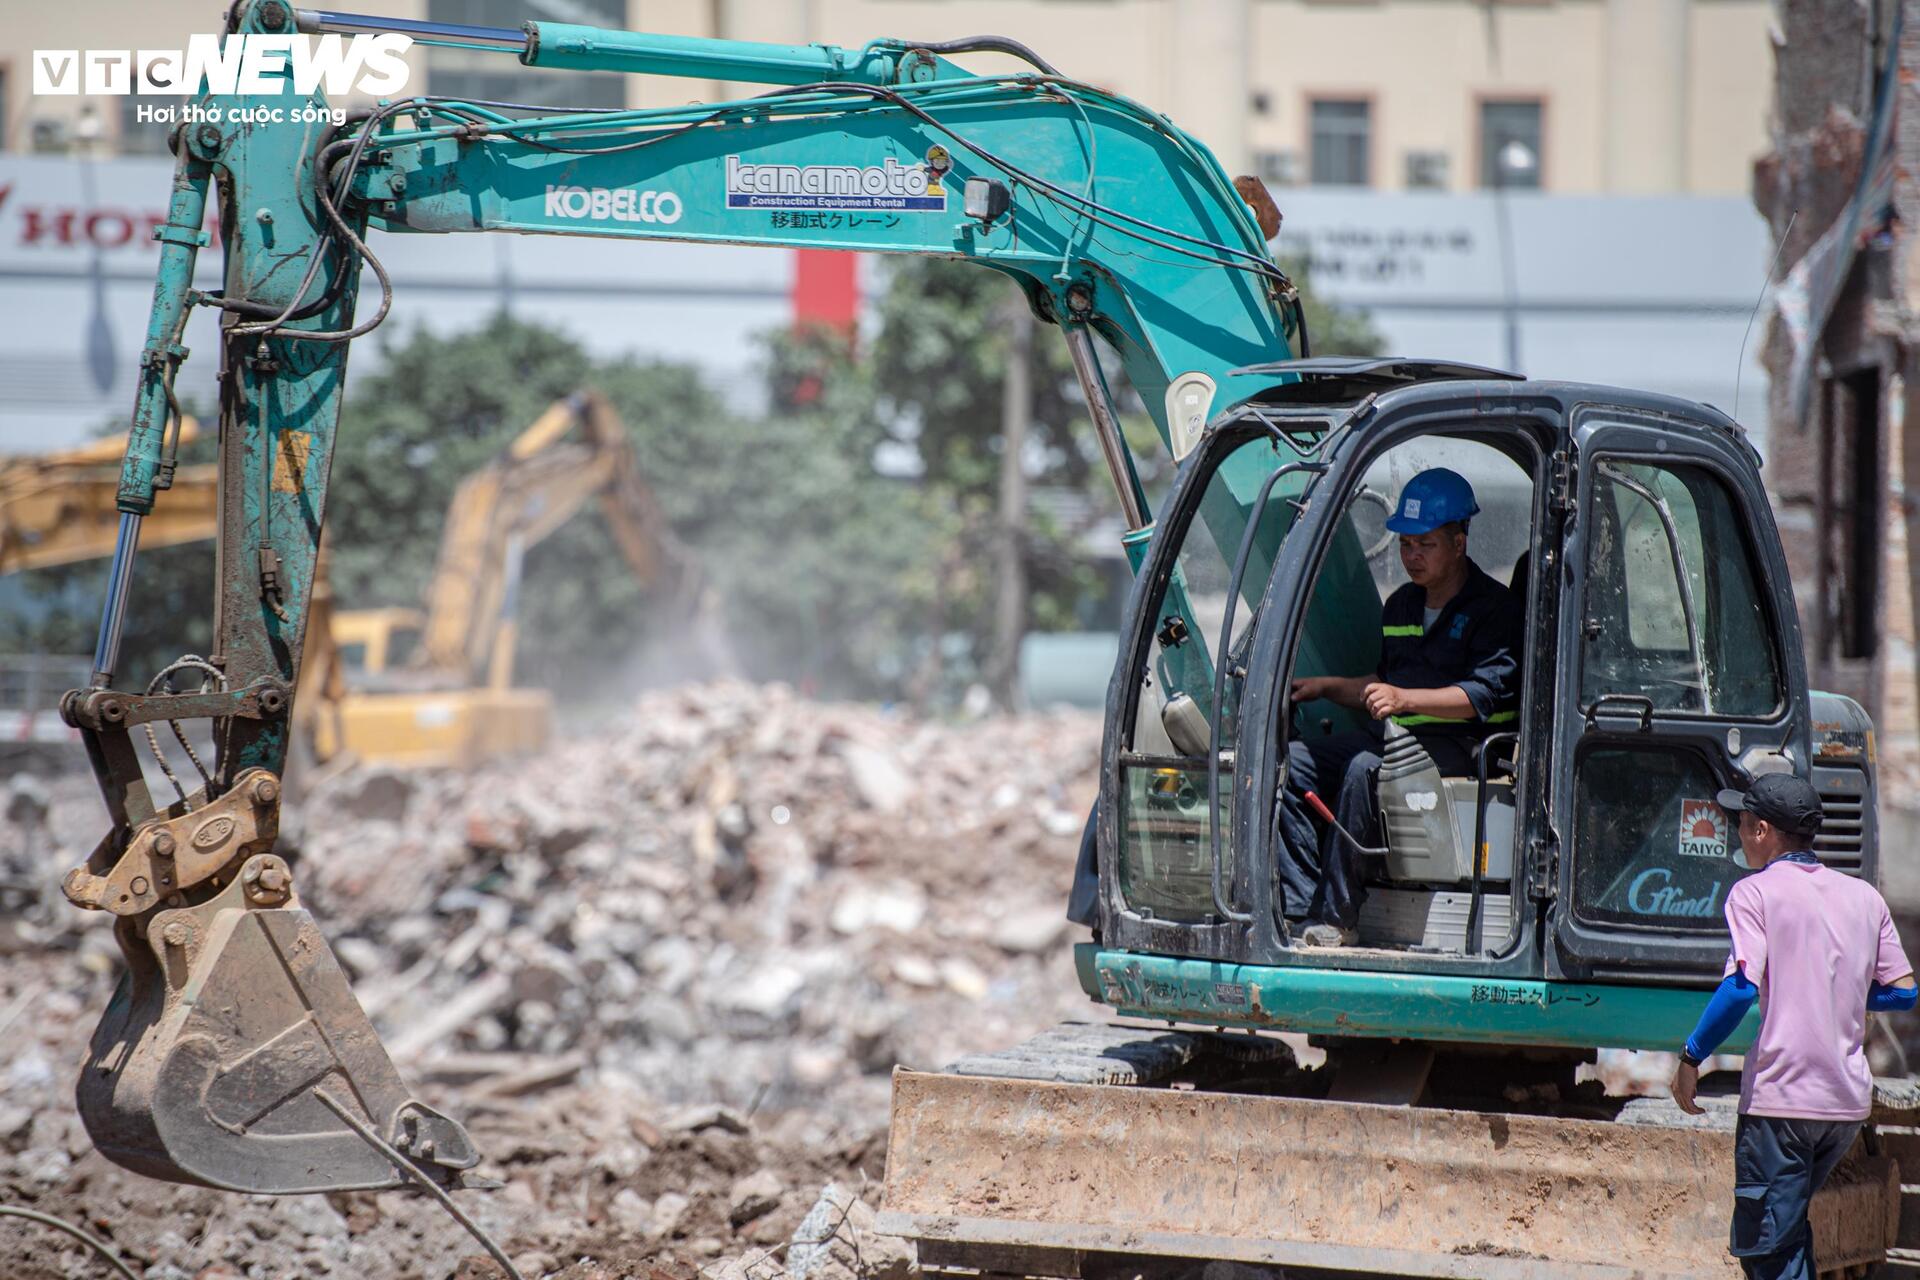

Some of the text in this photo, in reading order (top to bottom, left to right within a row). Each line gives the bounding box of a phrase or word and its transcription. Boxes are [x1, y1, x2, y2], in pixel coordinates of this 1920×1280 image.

[728, 156, 929, 196] kanamoto
[545, 184, 683, 224] KOBELCO
[749, 196, 906, 209] Construction Equipment Rental
[771, 211, 901, 229] 移動式クレーン
[1680, 842, 1726, 856] TAIYO
[1628, 868, 1721, 917] Grand
[1471, 984, 1600, 1007] 移動式クレーン
